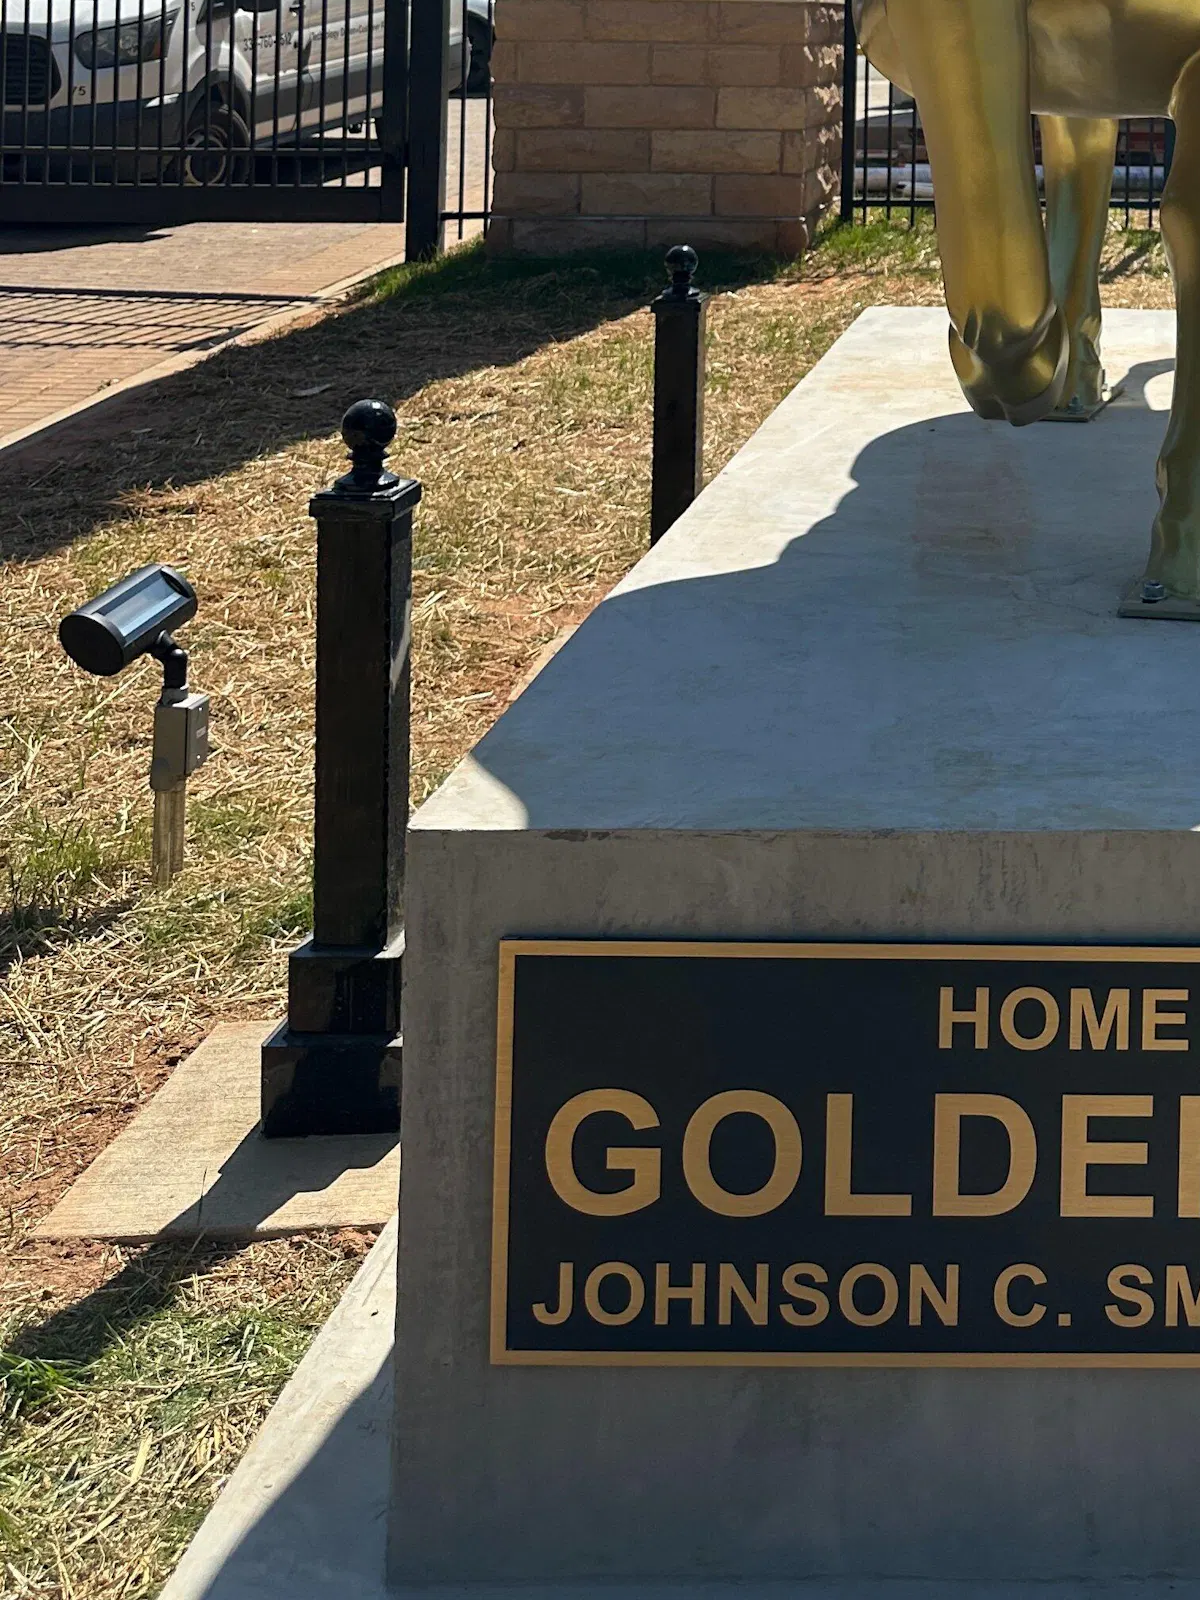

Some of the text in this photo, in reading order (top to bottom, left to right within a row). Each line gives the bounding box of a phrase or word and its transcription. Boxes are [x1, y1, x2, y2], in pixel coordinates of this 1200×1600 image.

[938, 986, 1189, 1052] HOME
[531, 1262, 960, 1327] JOHNSON
[993, 1263, 1071, 1328] C.
